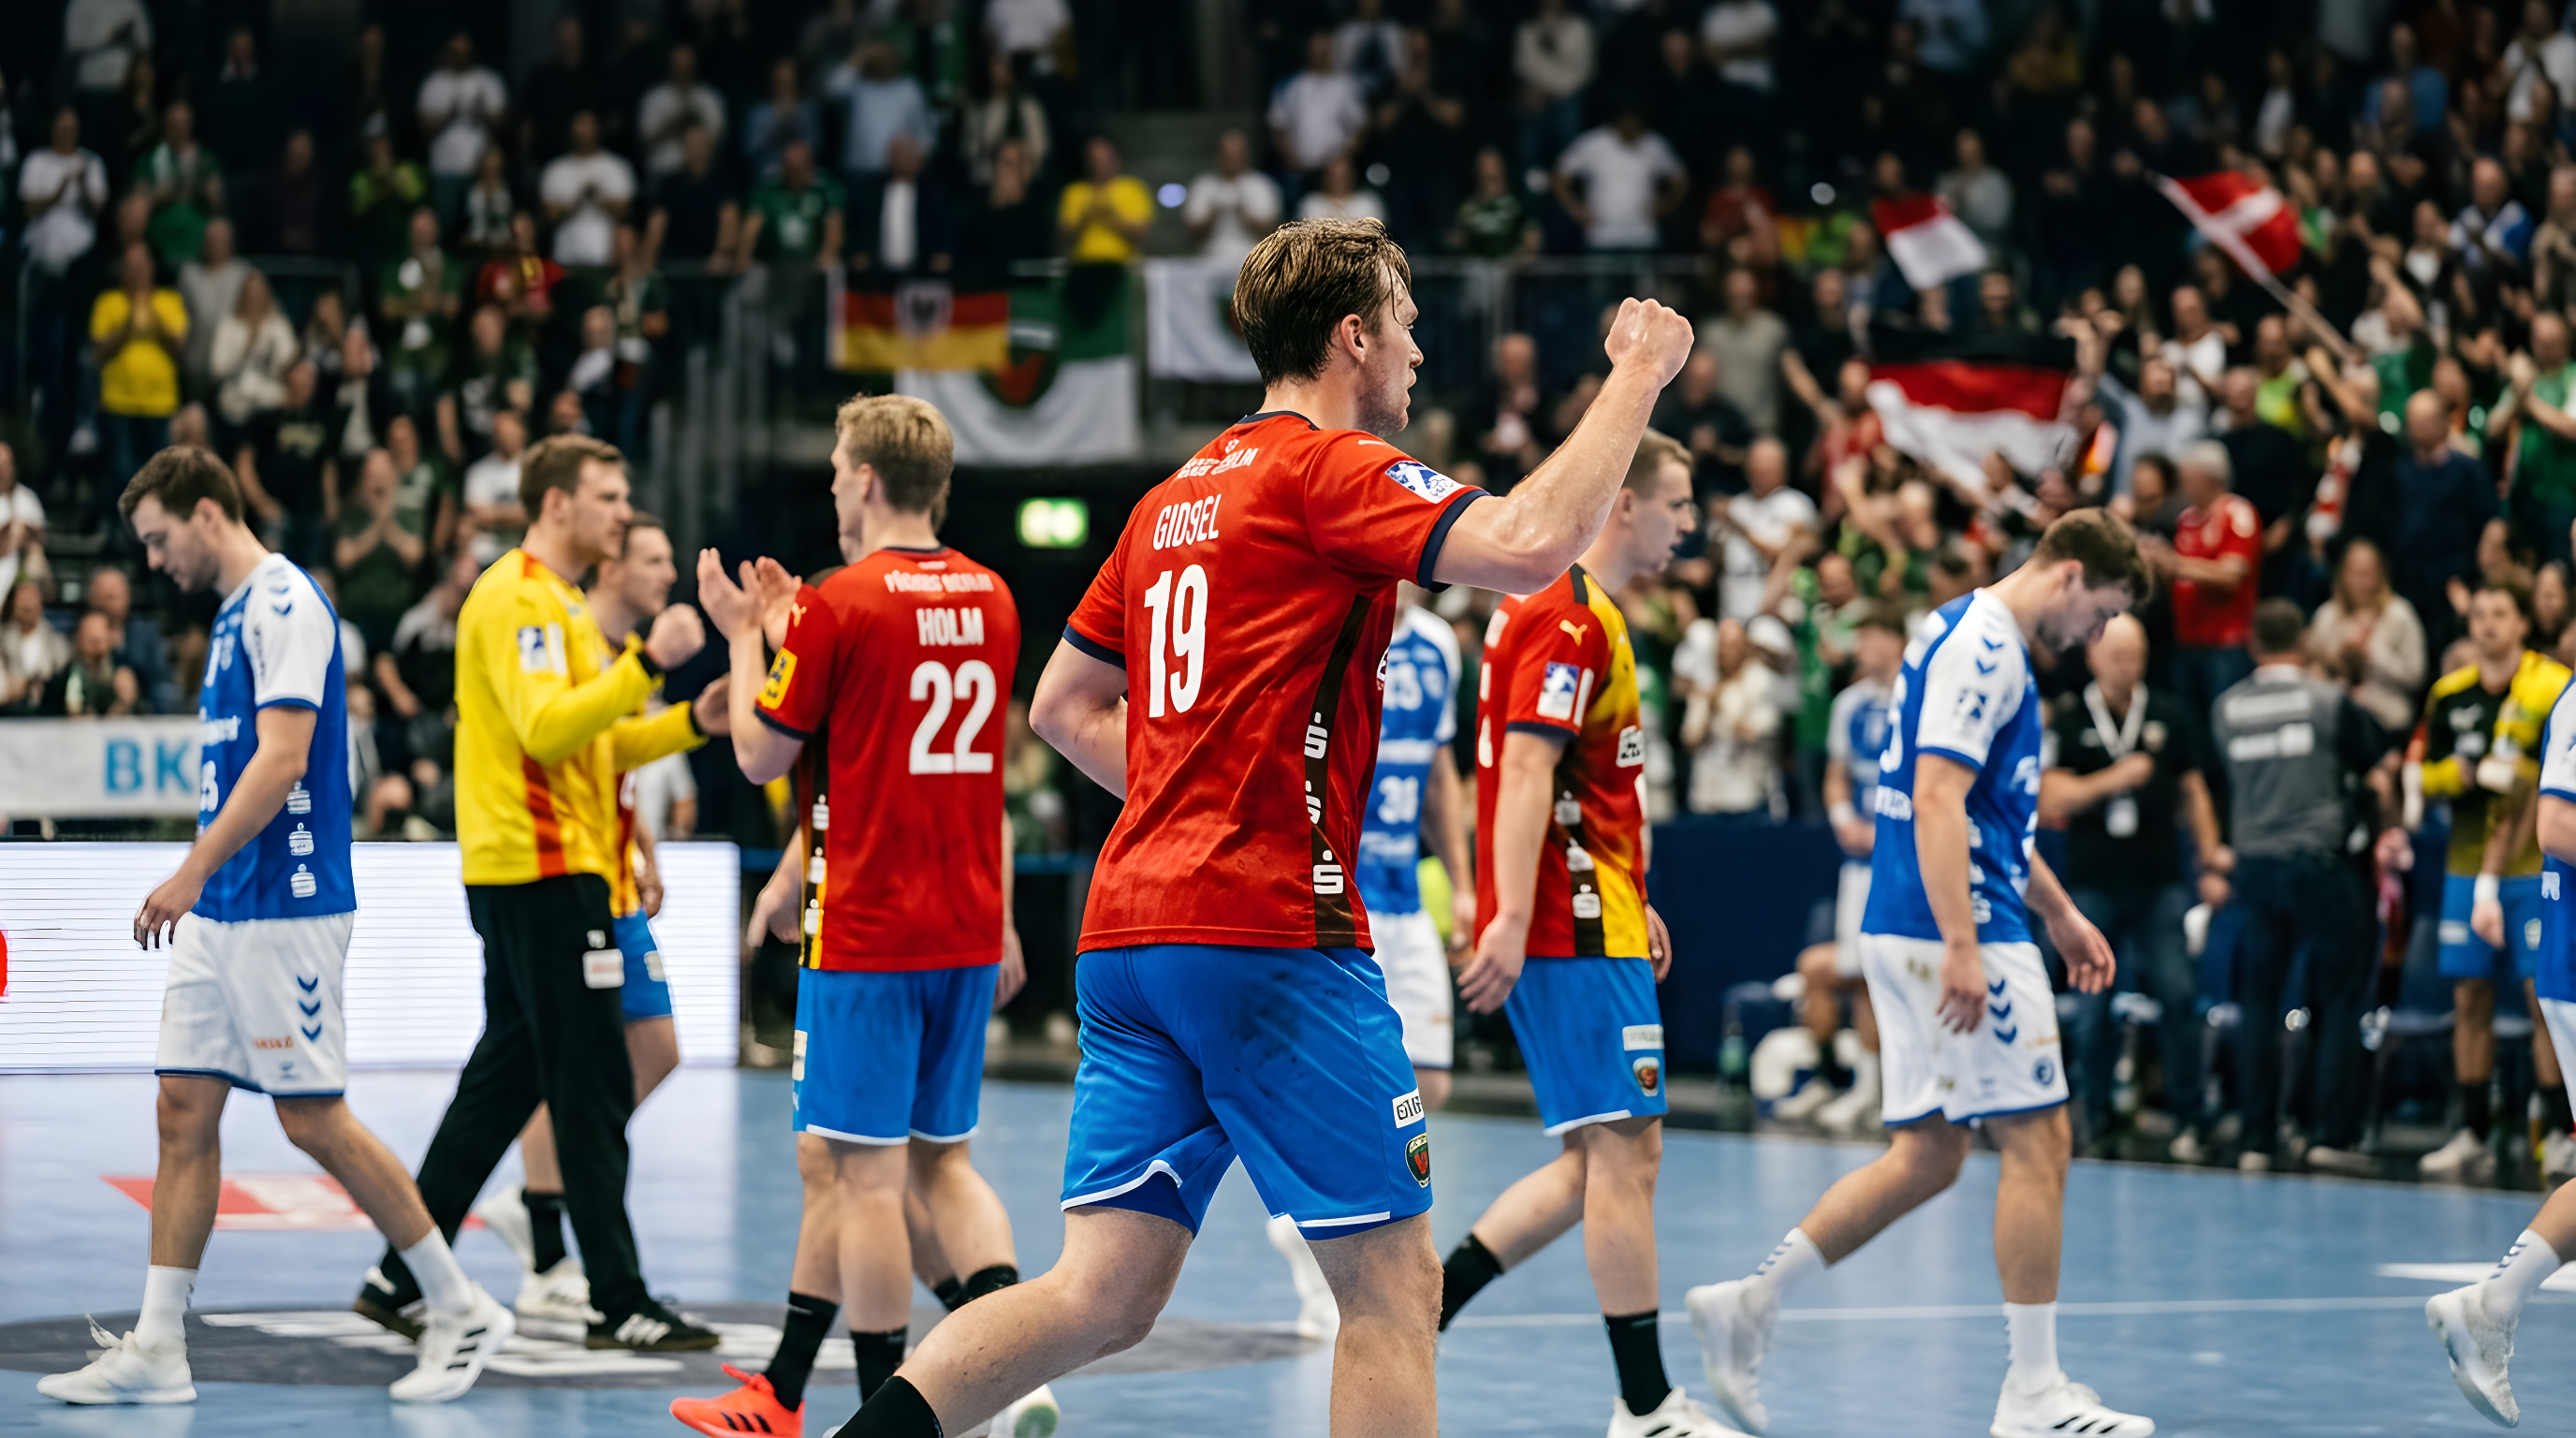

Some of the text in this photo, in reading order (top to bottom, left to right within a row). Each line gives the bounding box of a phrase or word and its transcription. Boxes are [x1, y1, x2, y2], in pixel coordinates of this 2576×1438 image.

[915, 607, 985, 647] HOLM
[1144, 564, 1208, 718] 19
[908, 659, 997, 775] 22
[1312, 864, 1344, 895] S
